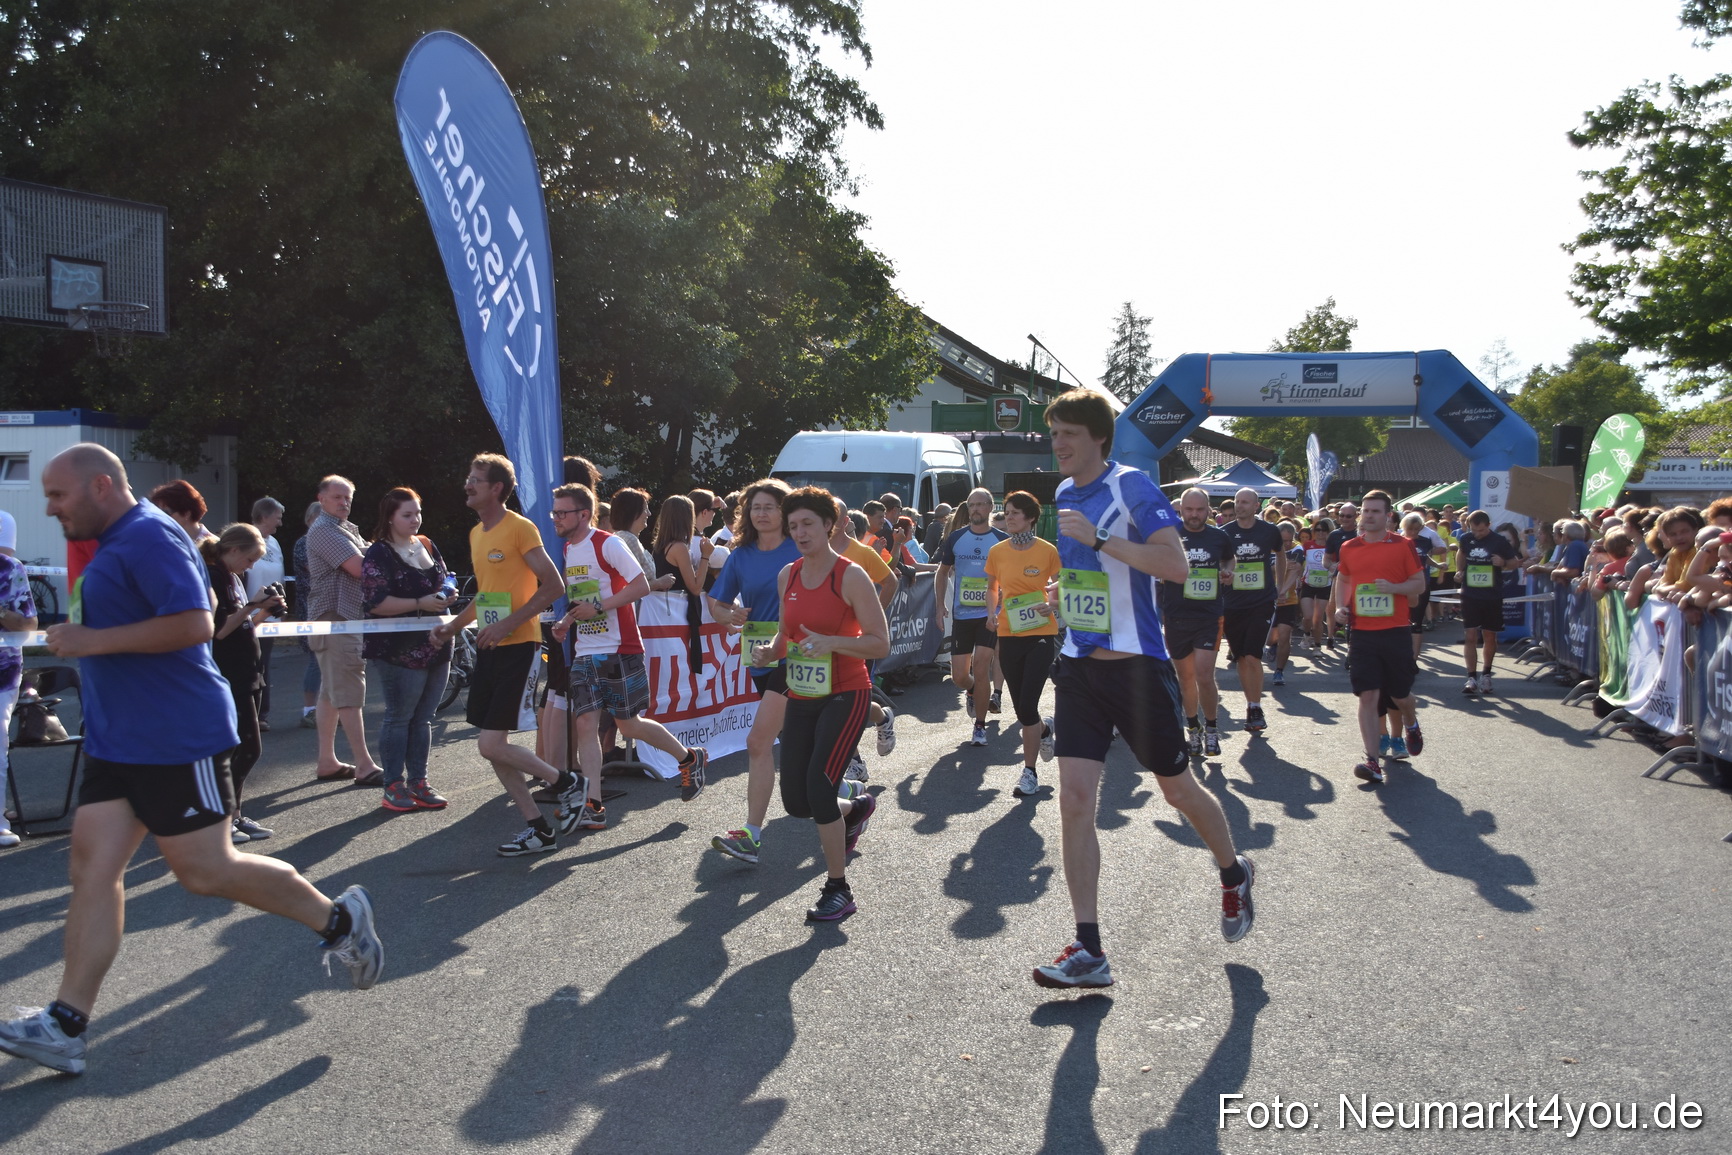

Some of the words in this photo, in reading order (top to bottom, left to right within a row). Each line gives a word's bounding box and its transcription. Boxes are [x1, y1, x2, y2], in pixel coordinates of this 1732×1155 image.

[1289, 383, 1368, 398] firmenlauf
[1145, 411, 1186, 421] Fischer
[1585, 467, 1612, 496] AOK
[1239, 573, 1258, 583] 168
[1472, 574, 1488, 582] 172
[1192, 580, 1212, 592] 169
[1064, 593, 1106, 616] 1125
[1359, 596, 1389, 608] 1171
[484, 610, 499, 624] 68
[789, 663, 826, 684] 1375
